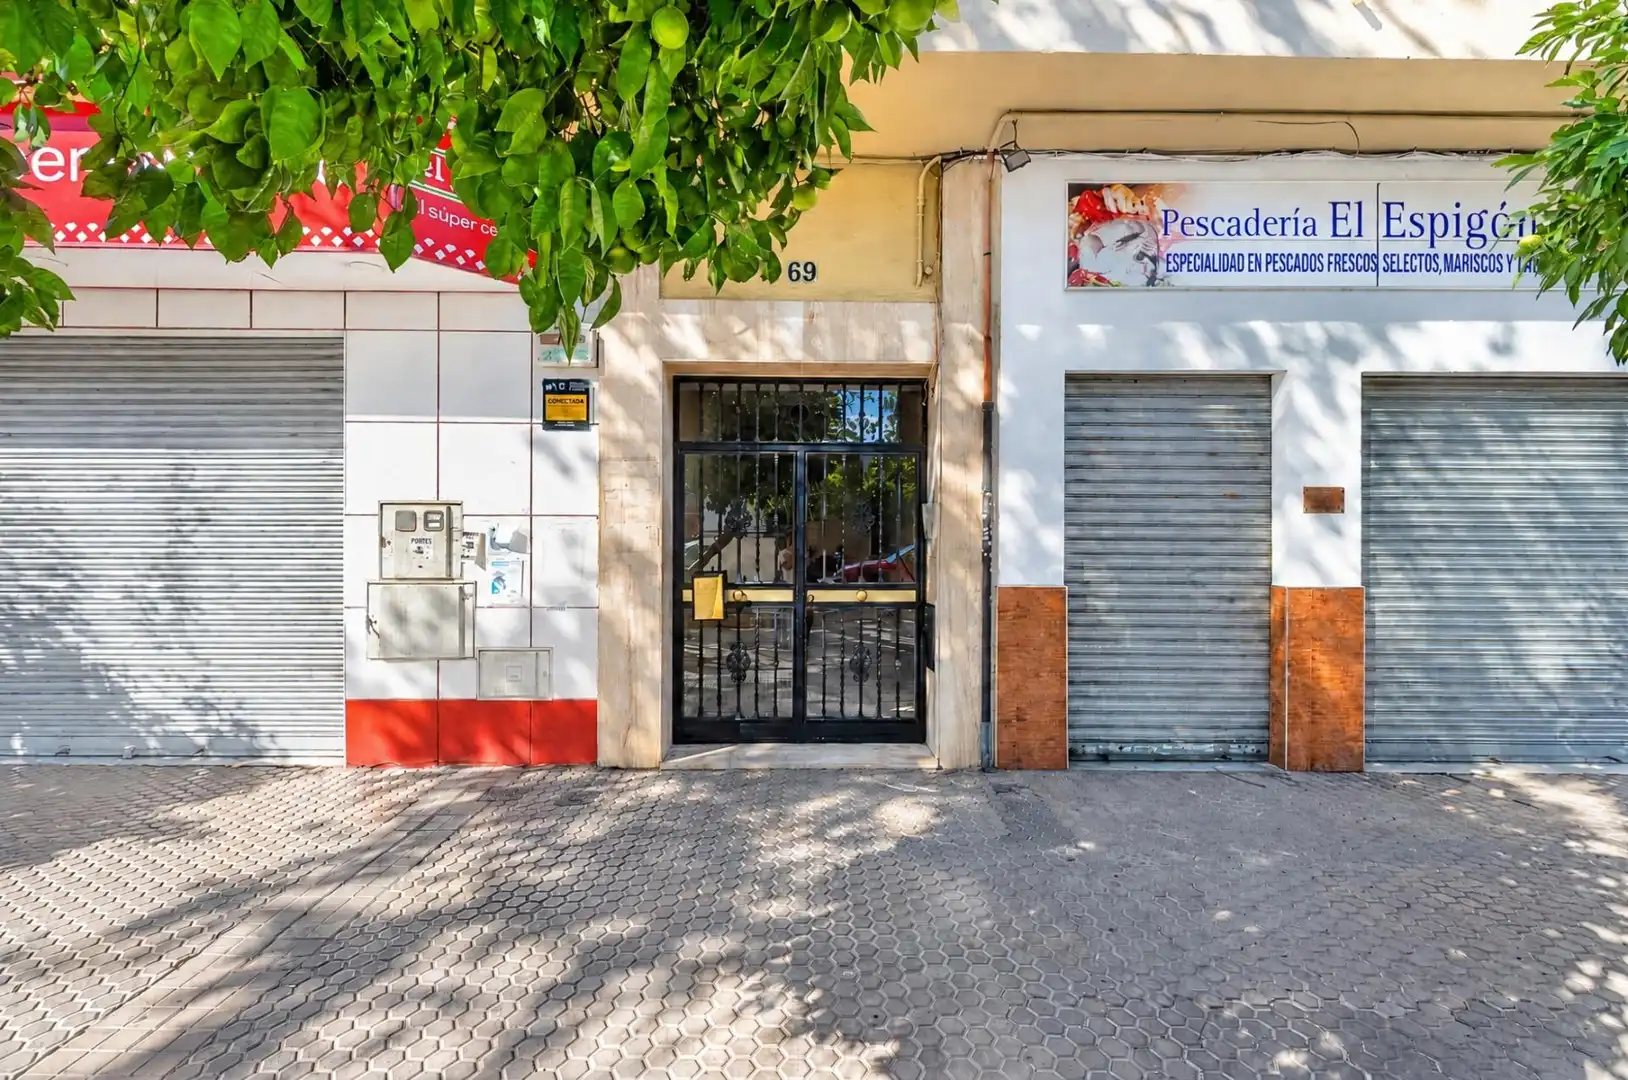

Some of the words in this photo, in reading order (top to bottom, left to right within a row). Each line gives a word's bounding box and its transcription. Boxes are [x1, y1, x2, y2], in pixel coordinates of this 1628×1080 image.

[1161, 206, 1317, 237] Pescadería
[1329, 200, 1363, 237] El
[788, 261, 817, 282] 69
[1166, 252, 1244, 273] ESPECIALIDAD
[1248, 253, 1262, 273] EN
[1265, 253, 1324, 273] PESCADOS
[1327, 253, 1376, 273] FRESCOS
